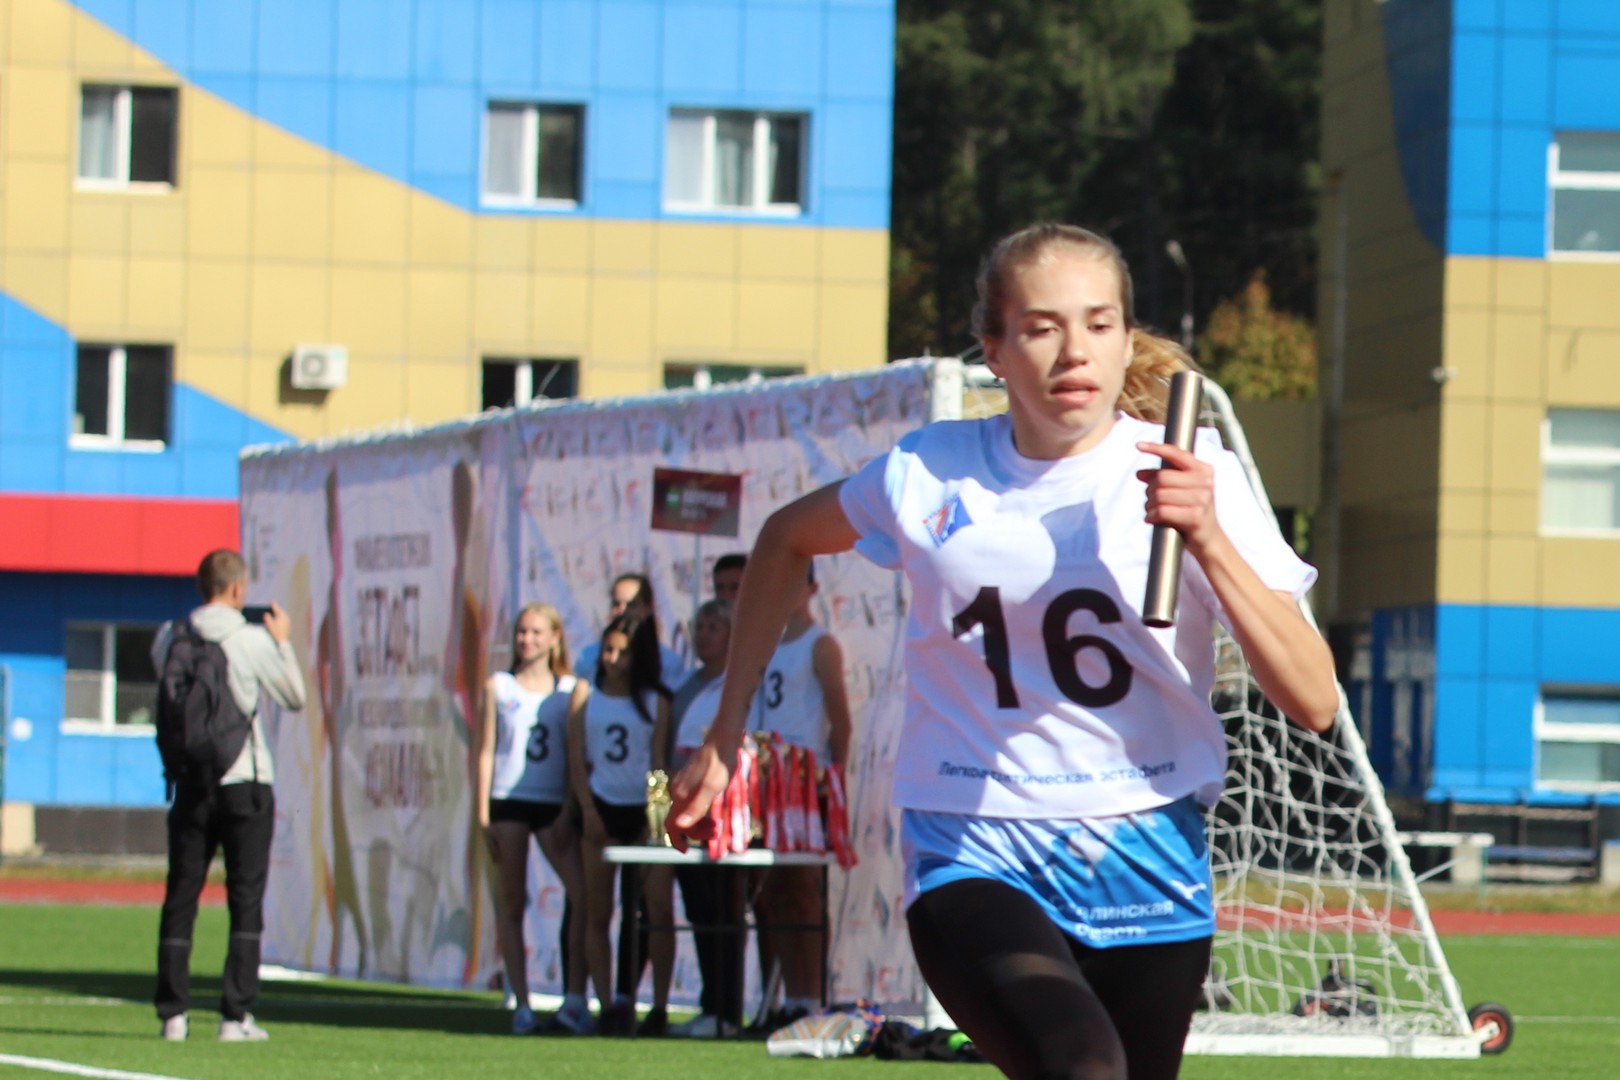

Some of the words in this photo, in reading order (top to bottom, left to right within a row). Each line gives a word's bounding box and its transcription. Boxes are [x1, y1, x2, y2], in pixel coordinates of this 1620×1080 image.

[953, 586, 1133, 708] 16
[766, 670, 783, 709] 3
[527, 723, 549, 763] 3
[605, 723, 630, 763] 3
[1100, 760, 1176, 782] эстафета
